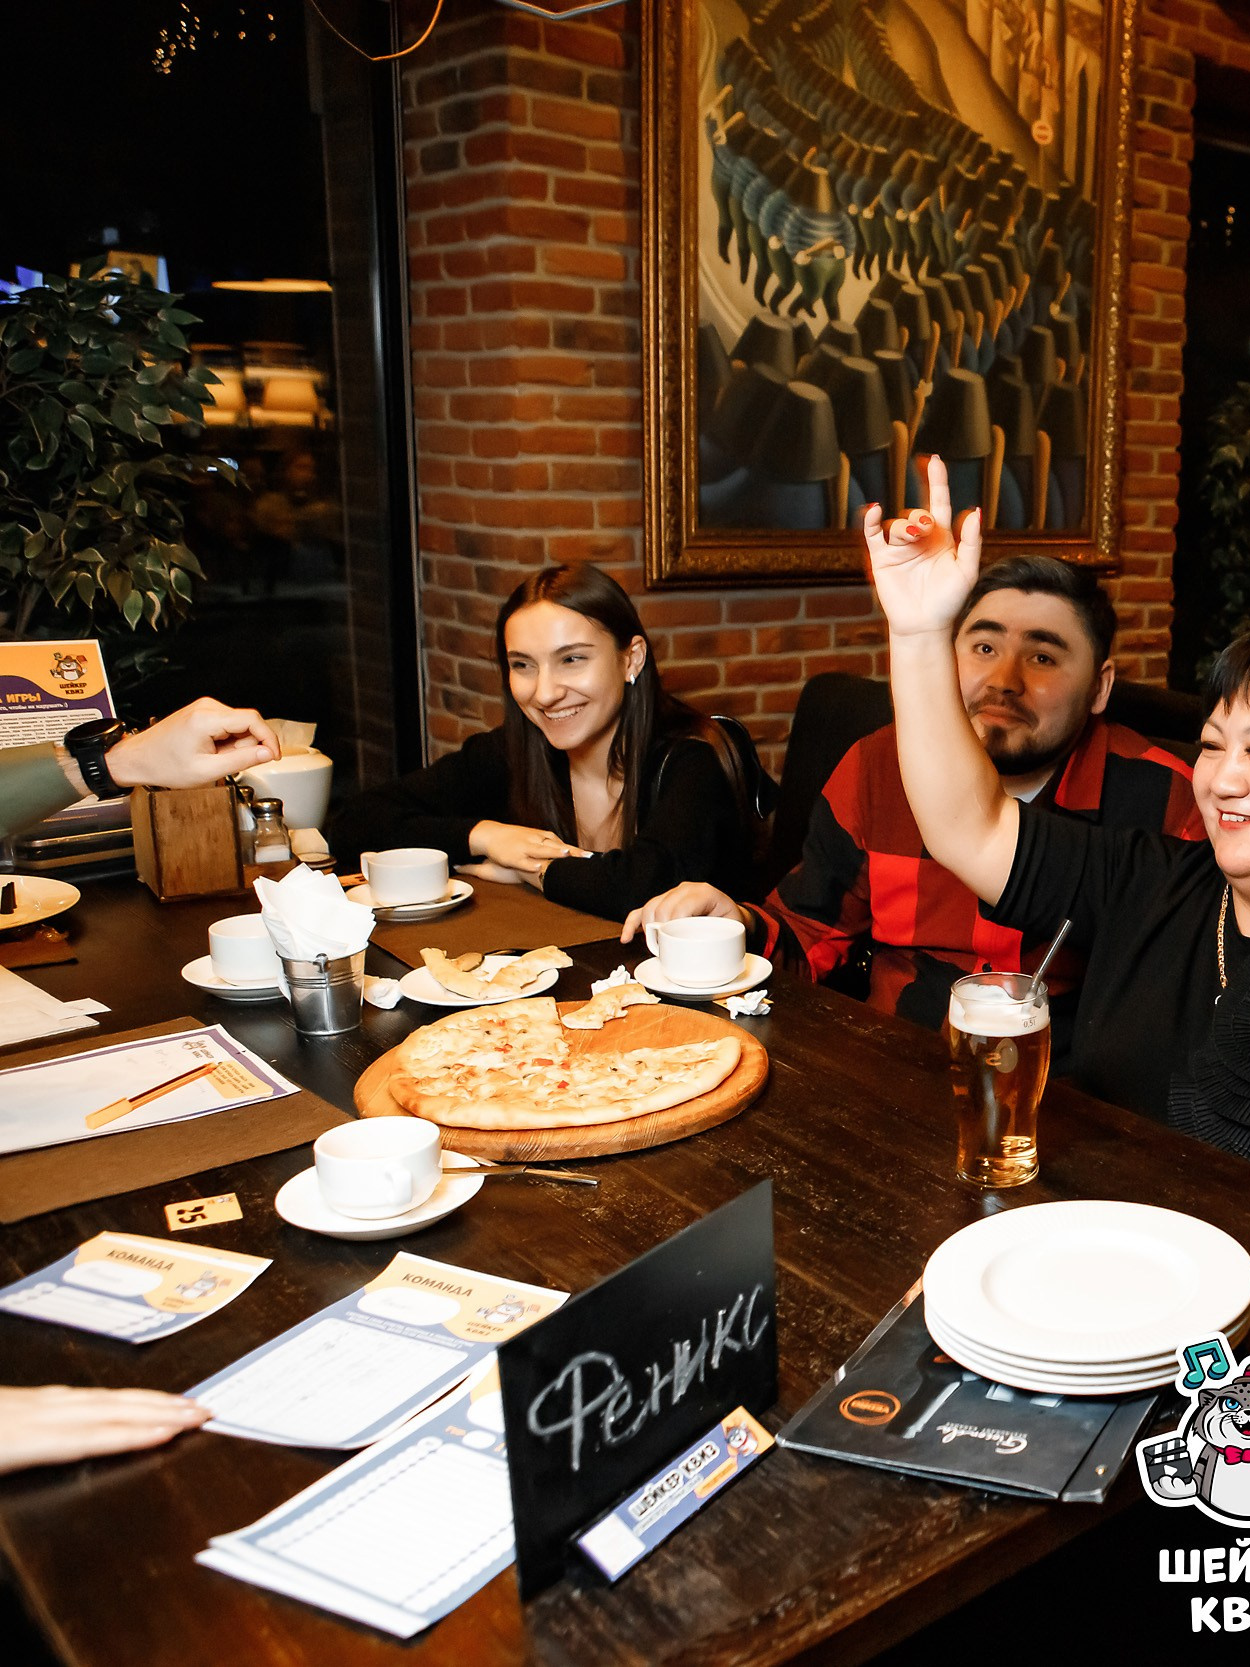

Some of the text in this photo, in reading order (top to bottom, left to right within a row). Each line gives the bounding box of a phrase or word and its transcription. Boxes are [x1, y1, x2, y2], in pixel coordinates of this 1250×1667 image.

[6, 692, 41, 703] ИГРЫ
[105, 1249, 174, 1272] КОМАНДА
[401, 1272, 473, 1297] КОМАНДА
[527, 1283, 769, 1472] Феникс
[630, 1470, 681, 1517] ШЕЙКЕР
[682, 1443, 717, 1474] КВИЗ
